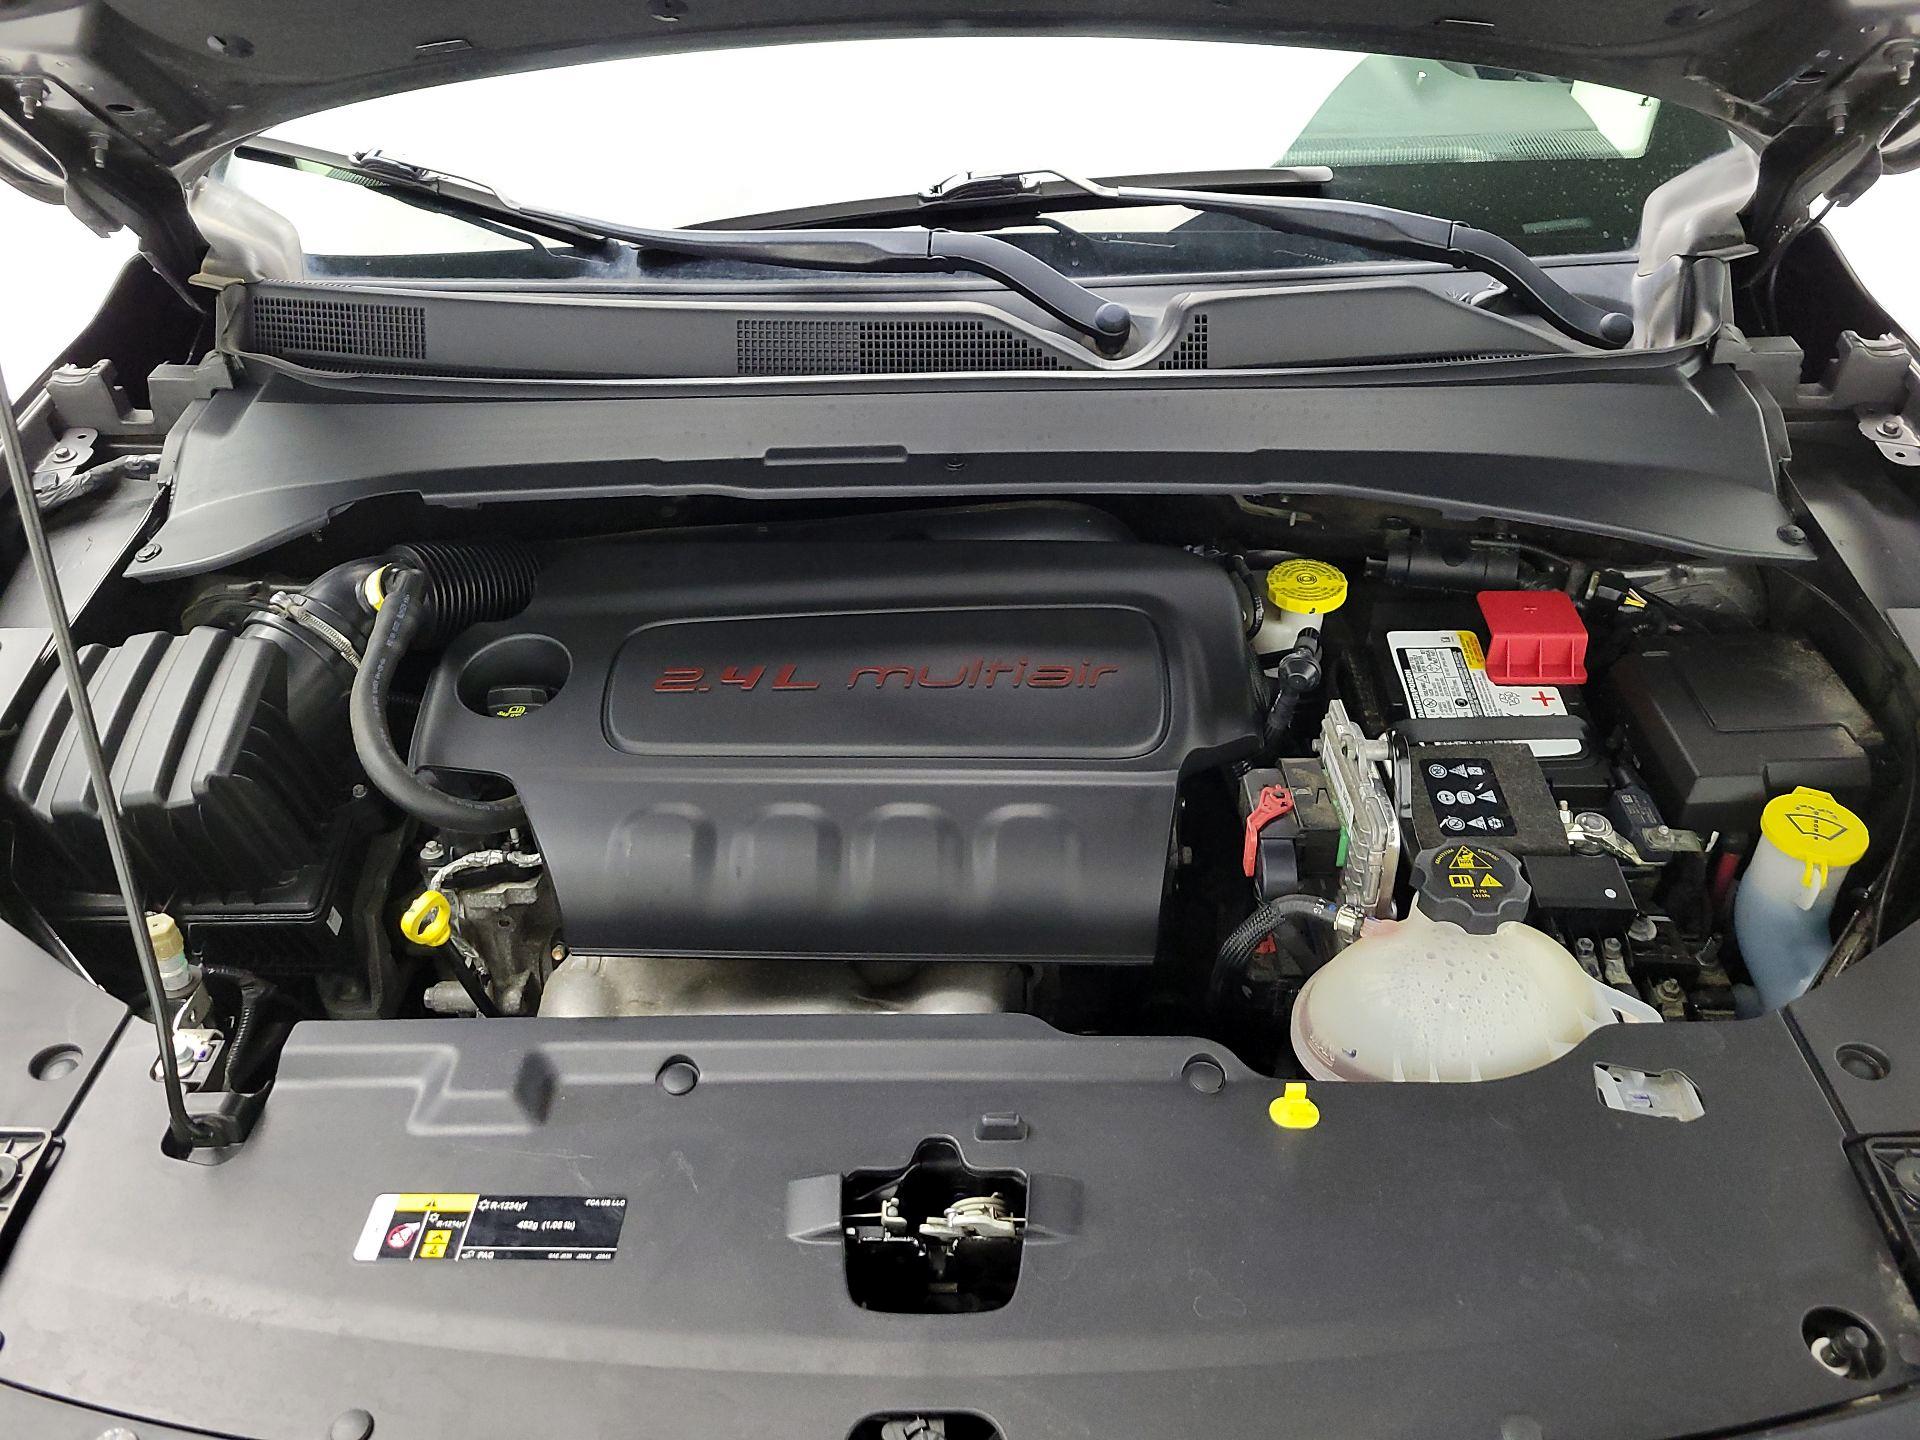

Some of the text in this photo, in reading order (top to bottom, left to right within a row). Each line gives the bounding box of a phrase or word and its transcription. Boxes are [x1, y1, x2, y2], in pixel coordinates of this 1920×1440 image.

[847, 657, 1119, 689] multiair
[585, 1199, 600, 1207] FCA
[600, 1199, 611, 1207] US
